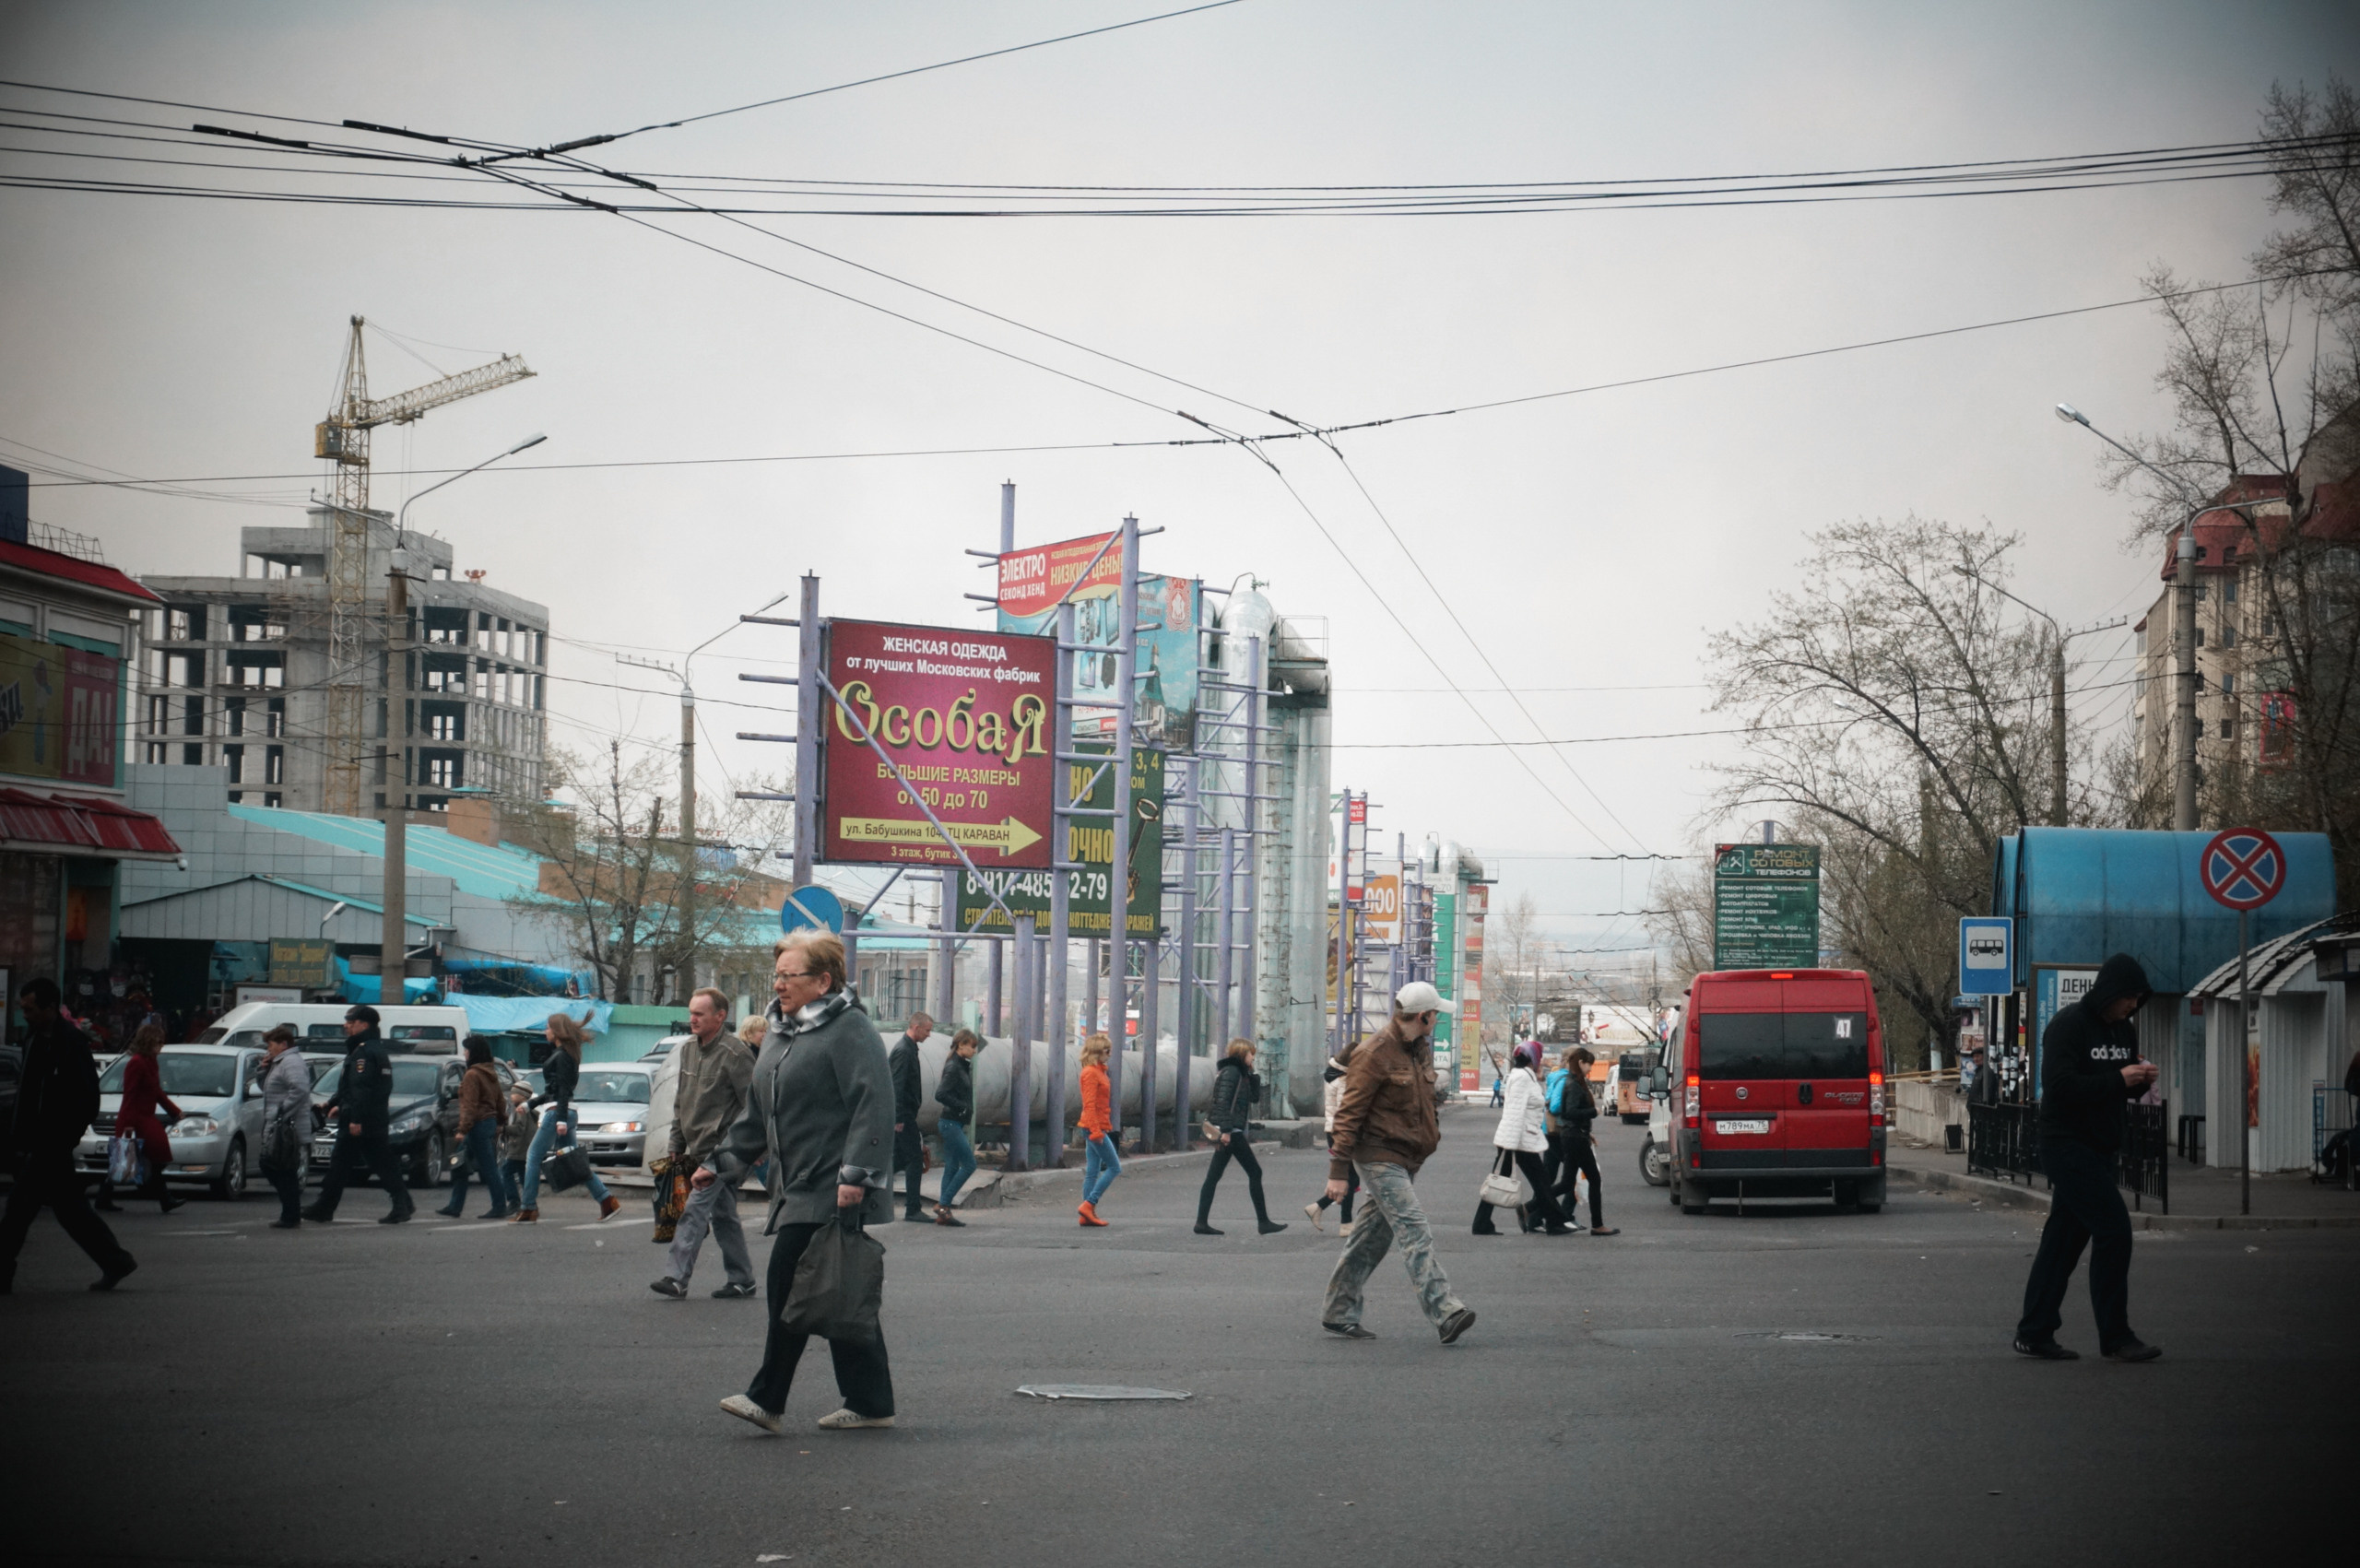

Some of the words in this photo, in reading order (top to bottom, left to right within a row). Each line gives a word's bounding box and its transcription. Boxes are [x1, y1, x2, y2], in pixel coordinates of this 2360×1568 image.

[1001, 553, 1045, 583] ЭЛЕКТРО
[1051, 560, 1089, 586] НИЗКИЕ
[1000, 584, 1026, 601] СЕКОНД
[1026, 582, 1045, 597] ХЕНД
[883, 636, 948, 655] ЖЕНСКАЯ
[950, 642, 1007, 663] ОДЕЖДА
[846, 656, 861, 668] от
[864, 658, 913, 673] лучших
[917, 659, 991, 679] Московских
[994, 666, 1040, 684] фабрик
[67, 687, 111, 774] ДА!
[835, 680, 1048, 764] ОсобаЯ
[878, 762, 950, 782] БОЛЬШИЕ
[953, 767, 1021, 786] РАЗМЕРЫ
[1136, 751, 1148, 774] 3,
[1150, 752, 1160, 771] 4
[1069, 766, 1093, 802] НО
[1130, 776, 1145, 789] ОМ
[922, 786, 939, 807] 50
[943, 793, 965, 810] до
[969, 789, 988, 809] 70
[846, 824, 862, 836] ул.
[865, 823, 921, 838] Бабушкина
[947, 827, 961, 841] ТЦ
[962, 828, 1009, 841] КАРАВАН
[891, 845, 897, 856] 3
[899, 848, 923, 859] этаж,
[925, 847, 950, 861] бутик
[1068, 826, 1115, 864] ОЧНО
[1750, 858, 1814, 867] СОТОВЫХ
[966, 871, 1107, 901] 8-914-4852-79
[1068, 912, 1111, 931] КОТТЕДЖЕ
[1125, 913, 1154, 931] АРАЖЕЙ
[2060, 978, 2095, 994] ДЕНЬ
